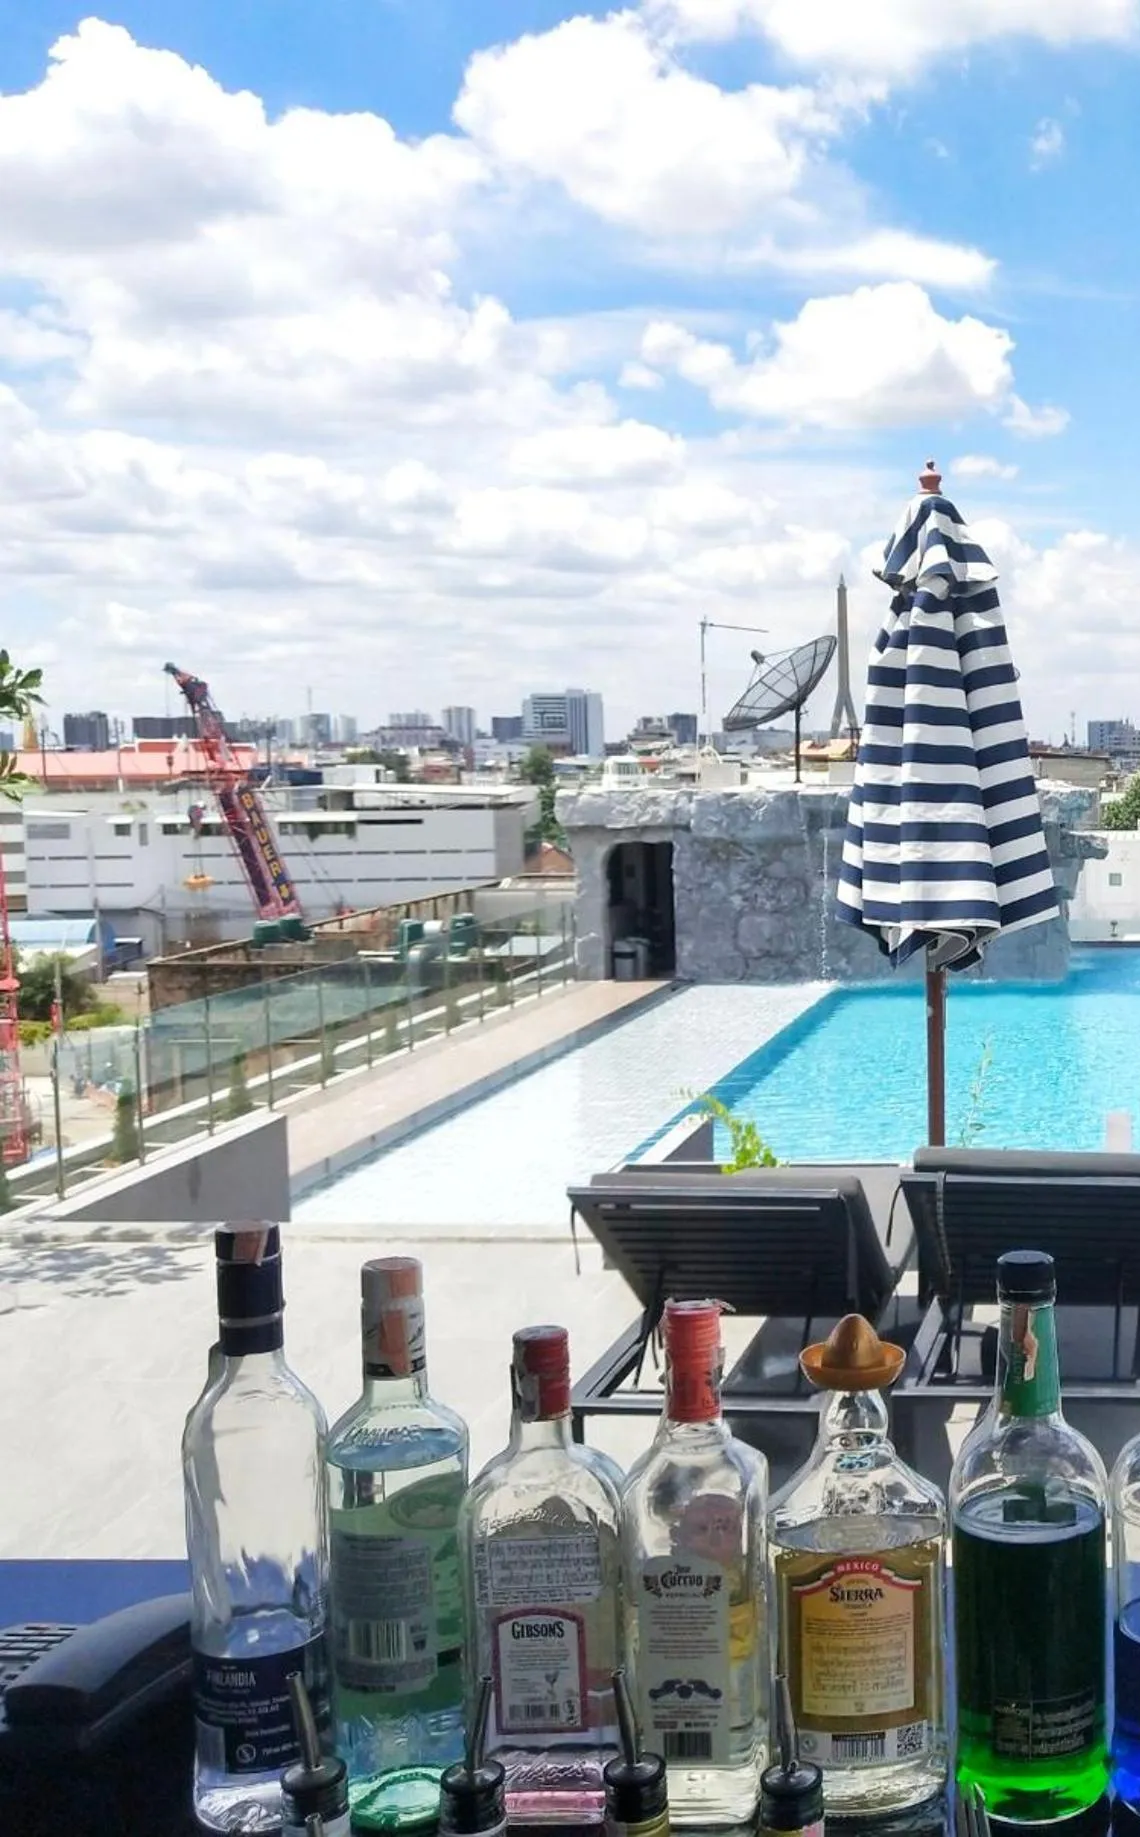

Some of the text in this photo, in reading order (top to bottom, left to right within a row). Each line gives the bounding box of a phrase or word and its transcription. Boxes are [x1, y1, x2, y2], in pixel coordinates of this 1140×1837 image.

[240, 791, 282, 878] BAUER
[836, 1561, 881, 1573] MEXICO
[660, 1570, 704, 1590] Cuervo
[829, 1586, 884, 1602] SIERRA
